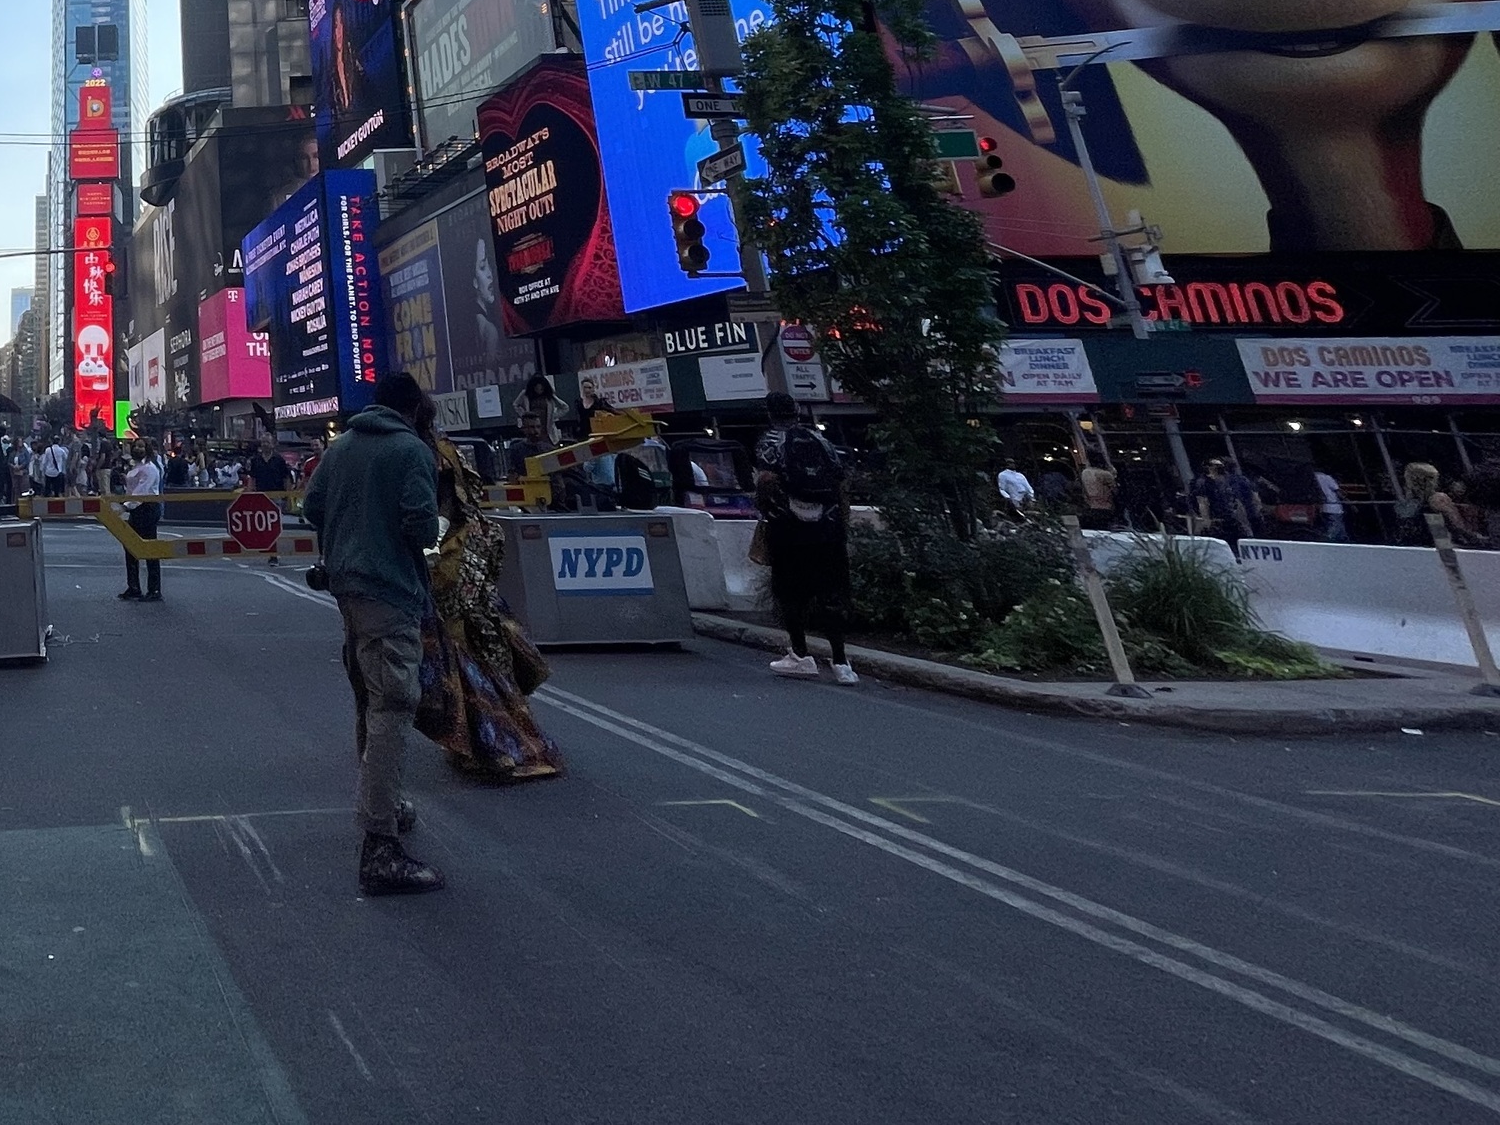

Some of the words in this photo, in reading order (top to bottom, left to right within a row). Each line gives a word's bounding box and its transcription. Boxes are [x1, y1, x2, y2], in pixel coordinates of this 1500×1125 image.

[604, 18, 635, 66] still
[637, 11, 665, 46] be
[85, 78, 106, 87] 2022
[695, 99, 721, 112] ONE
[337, 132, 358, 161] MICKEY
[357, 108, 384, 141] GUYTON
[485, 126, 550, 173] BROADWAY'S
[501, 151, 535, 180] MOST
[488, 159, 558, 217] SPECTACULAR
[340, 195, 348, 211] FOR
[294, 208, 319, 236] METALLICA
[349, 196, 365, 242] TAKE
[496, 204, 528, 236] NIGHT
[344, 239, 352, 257] FOR
[345, 257, 354, 274] THE
[83, 252, 104, 306] 中秋快乐
[309, 277, 324, 296] CAREY
[354, 252, 371, 327] ACTION
[393, 292, 433, 332] COME
[1016, 283, 1110, 325] DOS
[1139, 281, 1345, 324] CAMINOS
[350, 309, 358, 321] TO
[351, 322, 360, 341] END
[664, 328, 708, 353] BLUE
[714, 321, 747, 347] FIN
[246, 342, 271, 357] TH
[1013, 347, 1076, 356] BREAKFAST
[1028, 355, 1065, 363] LUNCH
[1261, 345, 1309, 367] DOS
[1318, 344, 1432, 367] CAMINOS
[361, 338, 376, 384] NOW
[795, 365, 810, 373] ALL
[1029, 362, 1070, 370] DINNER
[1021, 373, 1050, 381] OPEN
[1036, 379, 1047, 387] AT
[1253, 371, 1302, 389] WE
[1311, 371, 1366, 388] ARE
[1375, 370, 1453, 388] OPEN
[617, 387, 644, 404] OPEN
[435, 396, 469, 427] NSKI
[231, 511, 280, 533] STOP
[558, 546, 645, 578] NYPD
[1239, 544, 1283, 562] NYPD
